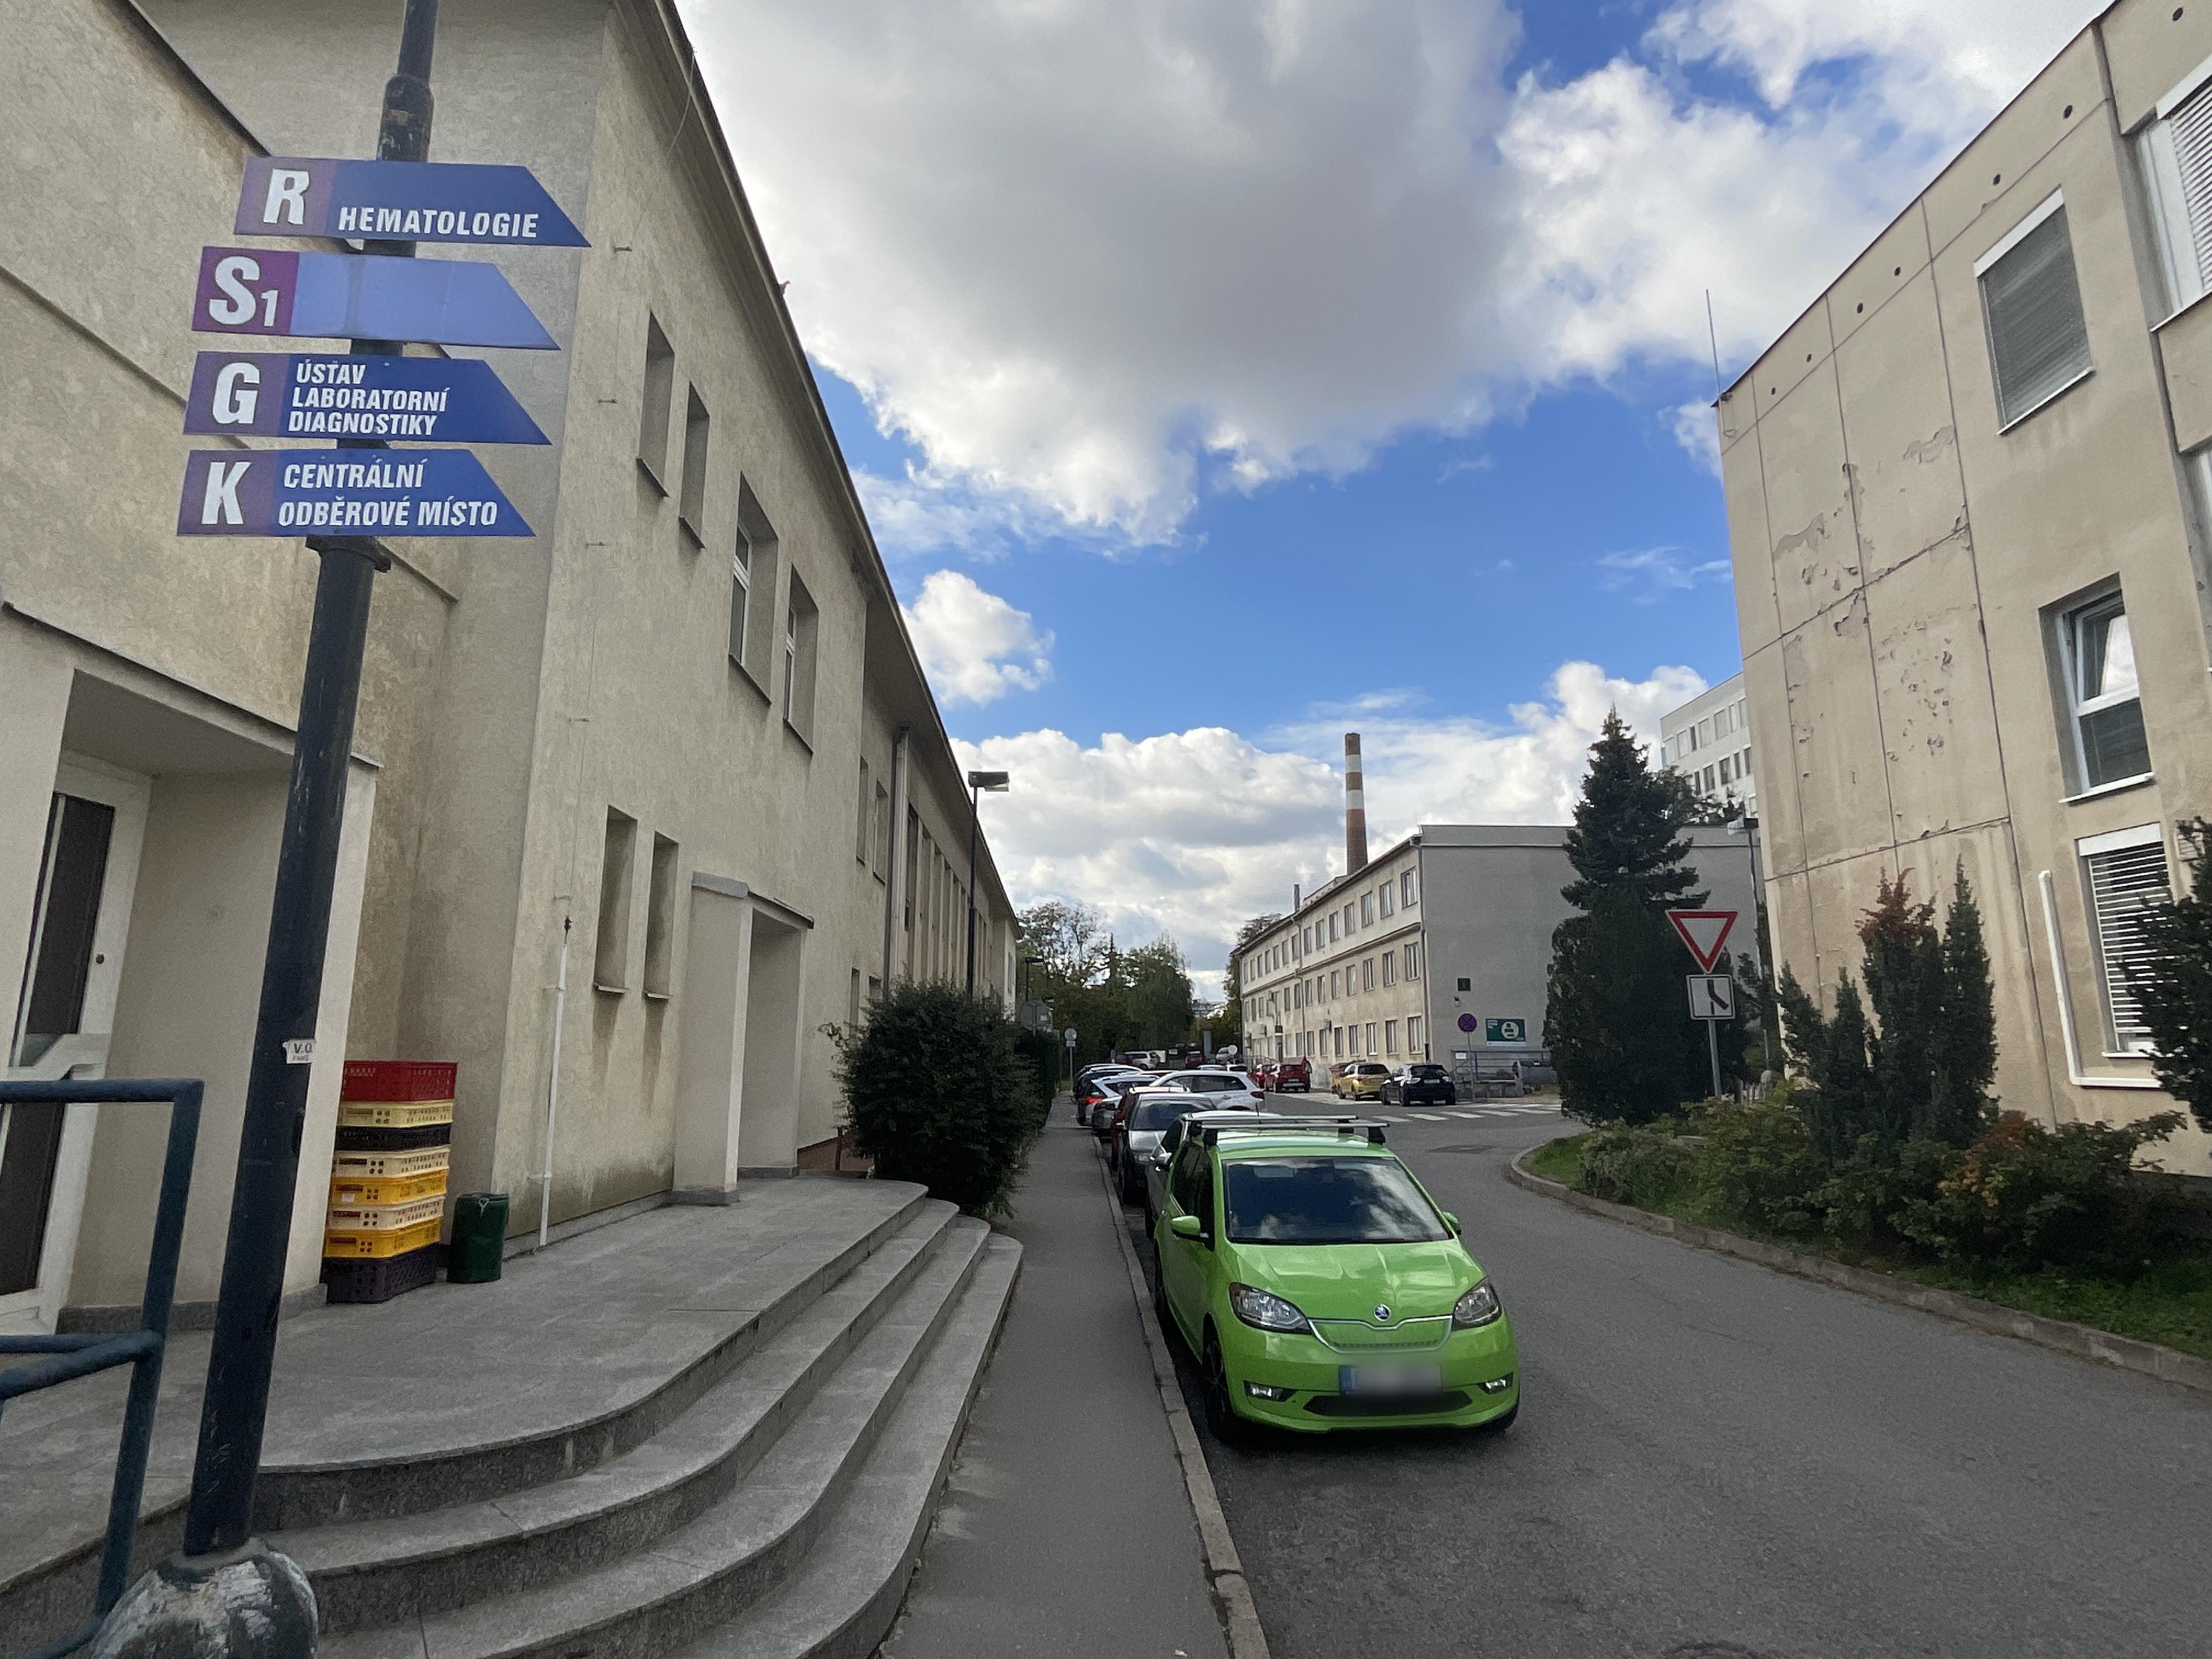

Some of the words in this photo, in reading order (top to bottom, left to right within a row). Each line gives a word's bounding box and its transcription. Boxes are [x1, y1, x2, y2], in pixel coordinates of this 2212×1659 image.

[263, 169, 310, 225] R
[338, 206, 539, 238] HEMATOLOGIE
[296, 359, 366, 384] ÚSTAV
[212, 362, 260, 424] G
[290, 387, 450, 412] LABORATORNÍ
[288, 411, 437, 435] DIAGNOSTIKY
[284, 458, 428, 488] CENTRÁLNÍ
[201, 461, 253, 525] K
[278, 495, 410, 526] ODBĚROVÉ
[417, 495, 497, 526] MÍSTO
